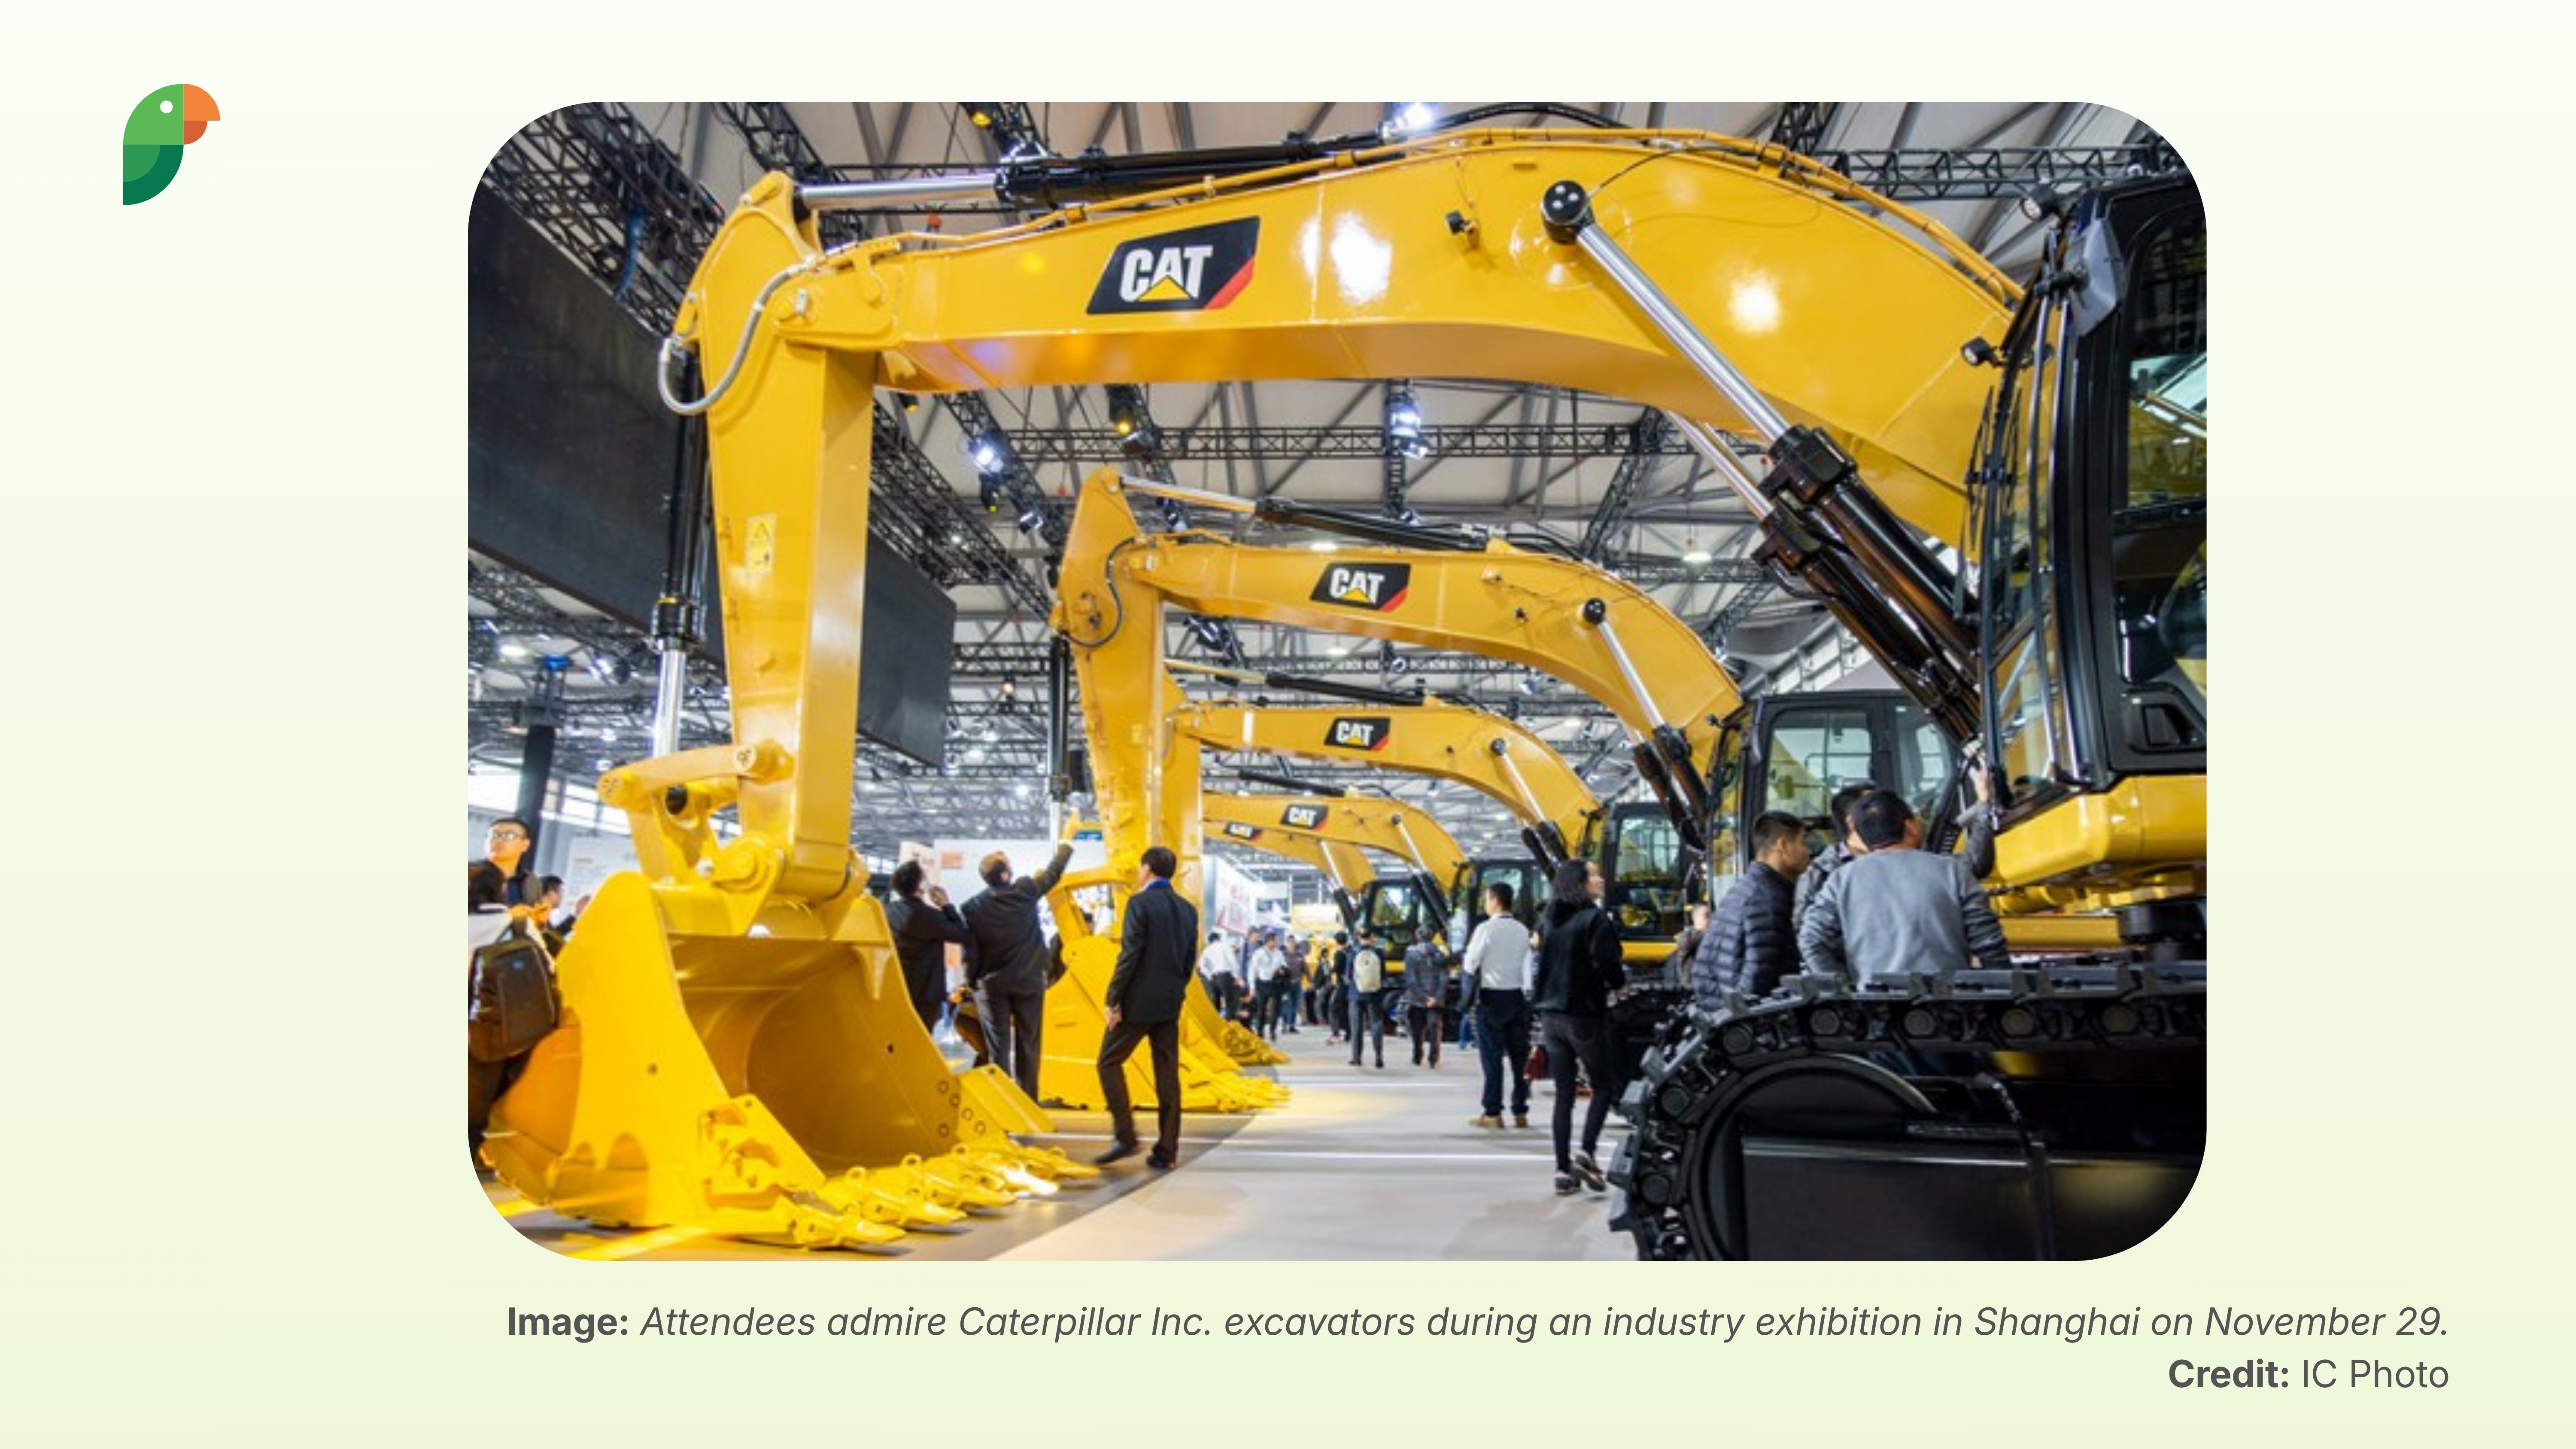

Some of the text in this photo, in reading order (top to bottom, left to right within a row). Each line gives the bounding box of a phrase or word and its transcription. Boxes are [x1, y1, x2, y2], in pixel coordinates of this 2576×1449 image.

[1119, 245, 1214, 302] CAT
[1330, 568, 1385, 605] CAT
[1336, 720, 1374, 746] CAT
[1288, 806, 1317, 826] CAT
